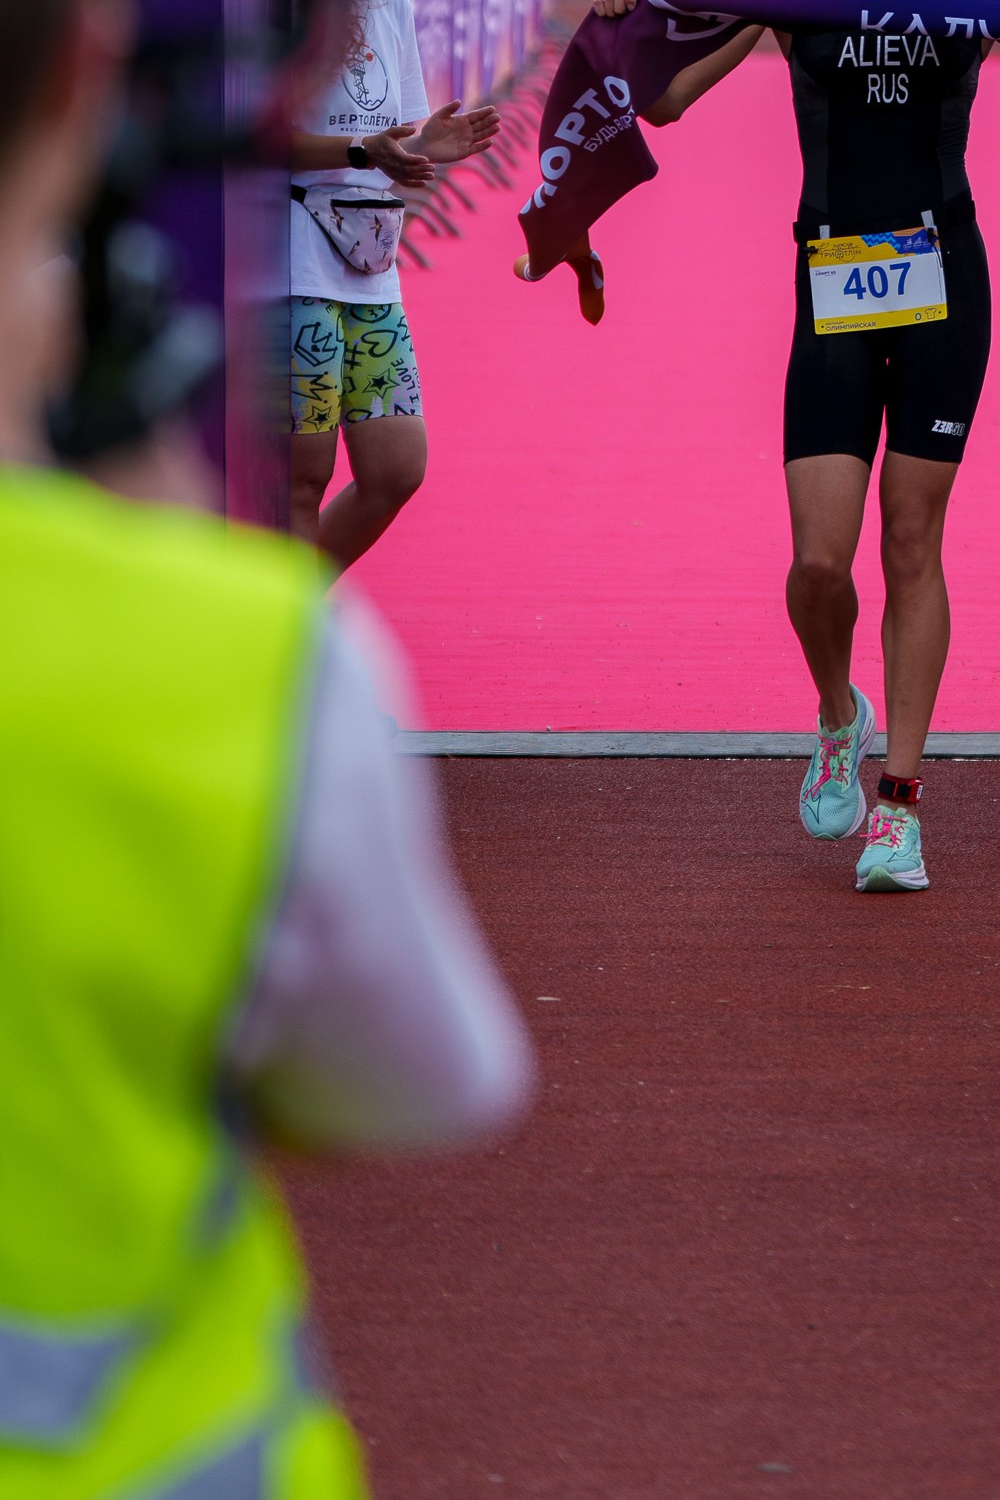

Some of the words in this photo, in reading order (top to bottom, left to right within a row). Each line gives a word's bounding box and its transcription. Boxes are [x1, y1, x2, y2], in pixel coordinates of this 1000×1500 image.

[837, 34, 941, 69] ALIEVA
[866, 72, 909, 105] RUS
[328, 112, 398, 127] ВЕРТОЛЁТКА
[842, 261, 912, 301] 407
[825, 321, 877, 332] ОЛИМПИЙСКАЯ
